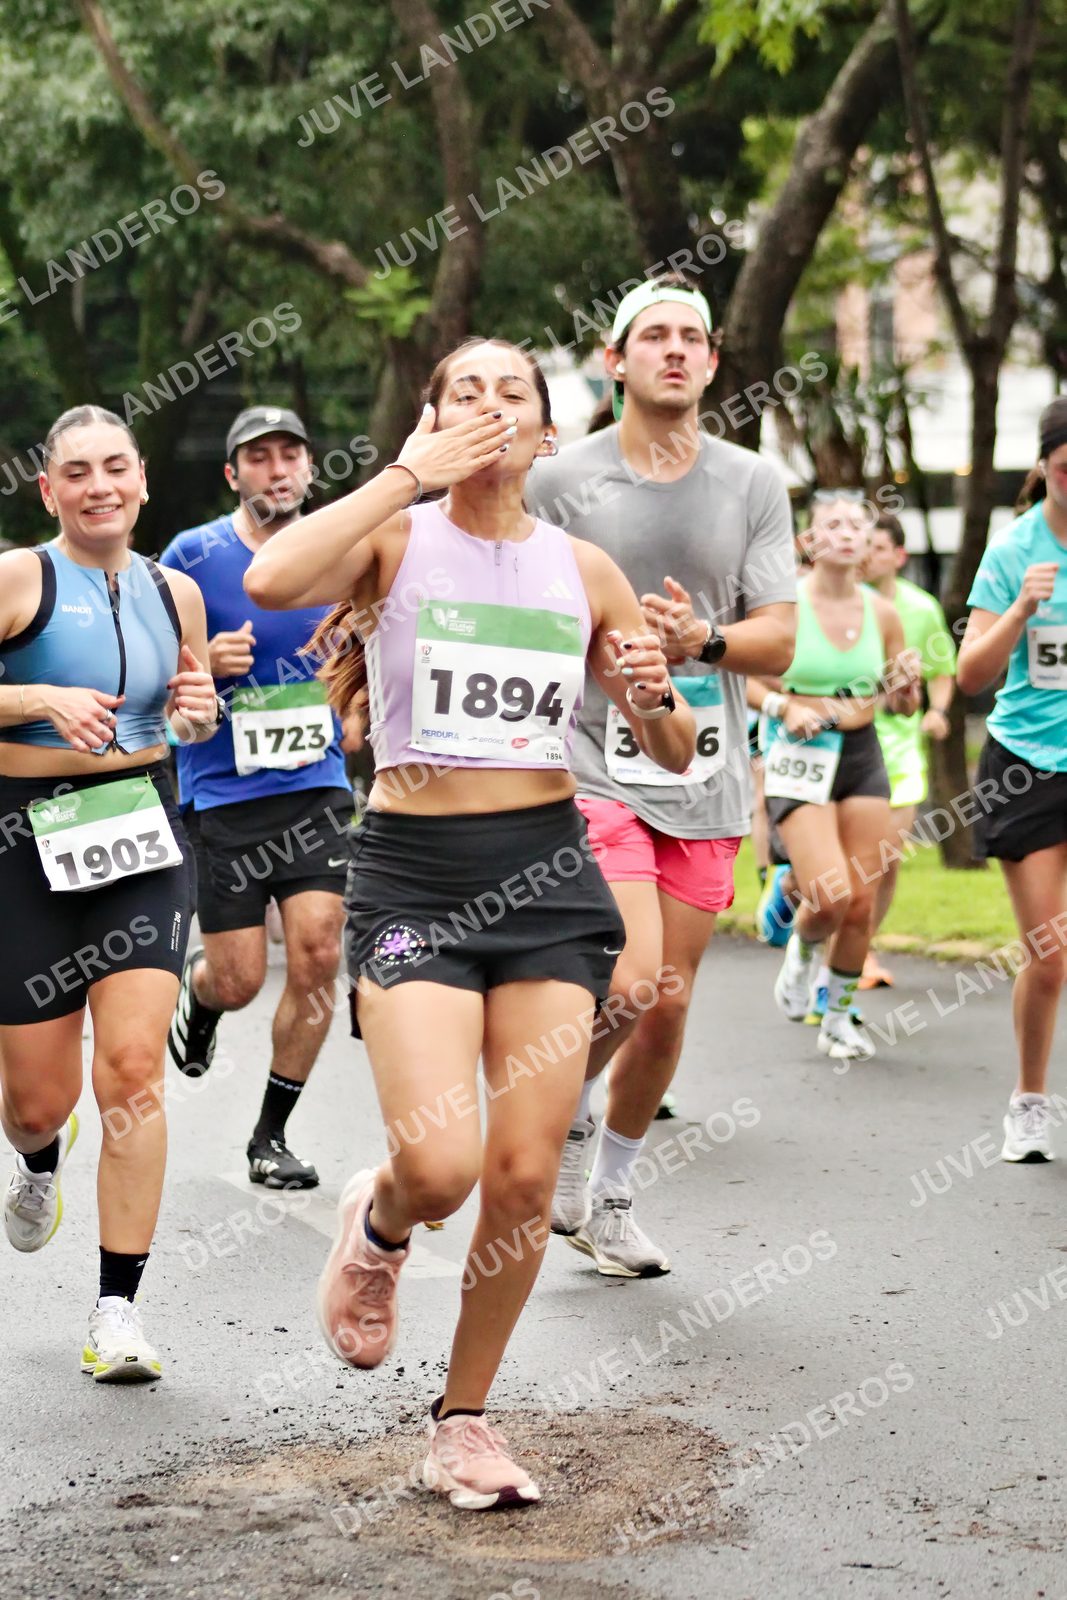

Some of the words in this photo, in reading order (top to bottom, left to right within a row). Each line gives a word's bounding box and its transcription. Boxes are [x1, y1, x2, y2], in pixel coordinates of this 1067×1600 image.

[61, 604, 93, 615] BANDIT
[430, 668, 564, 726] 1894
[244, 723, 326, 755] 1723
[545, 752, 563, 761] 1894
[54, 829, 169, 887] 1903
